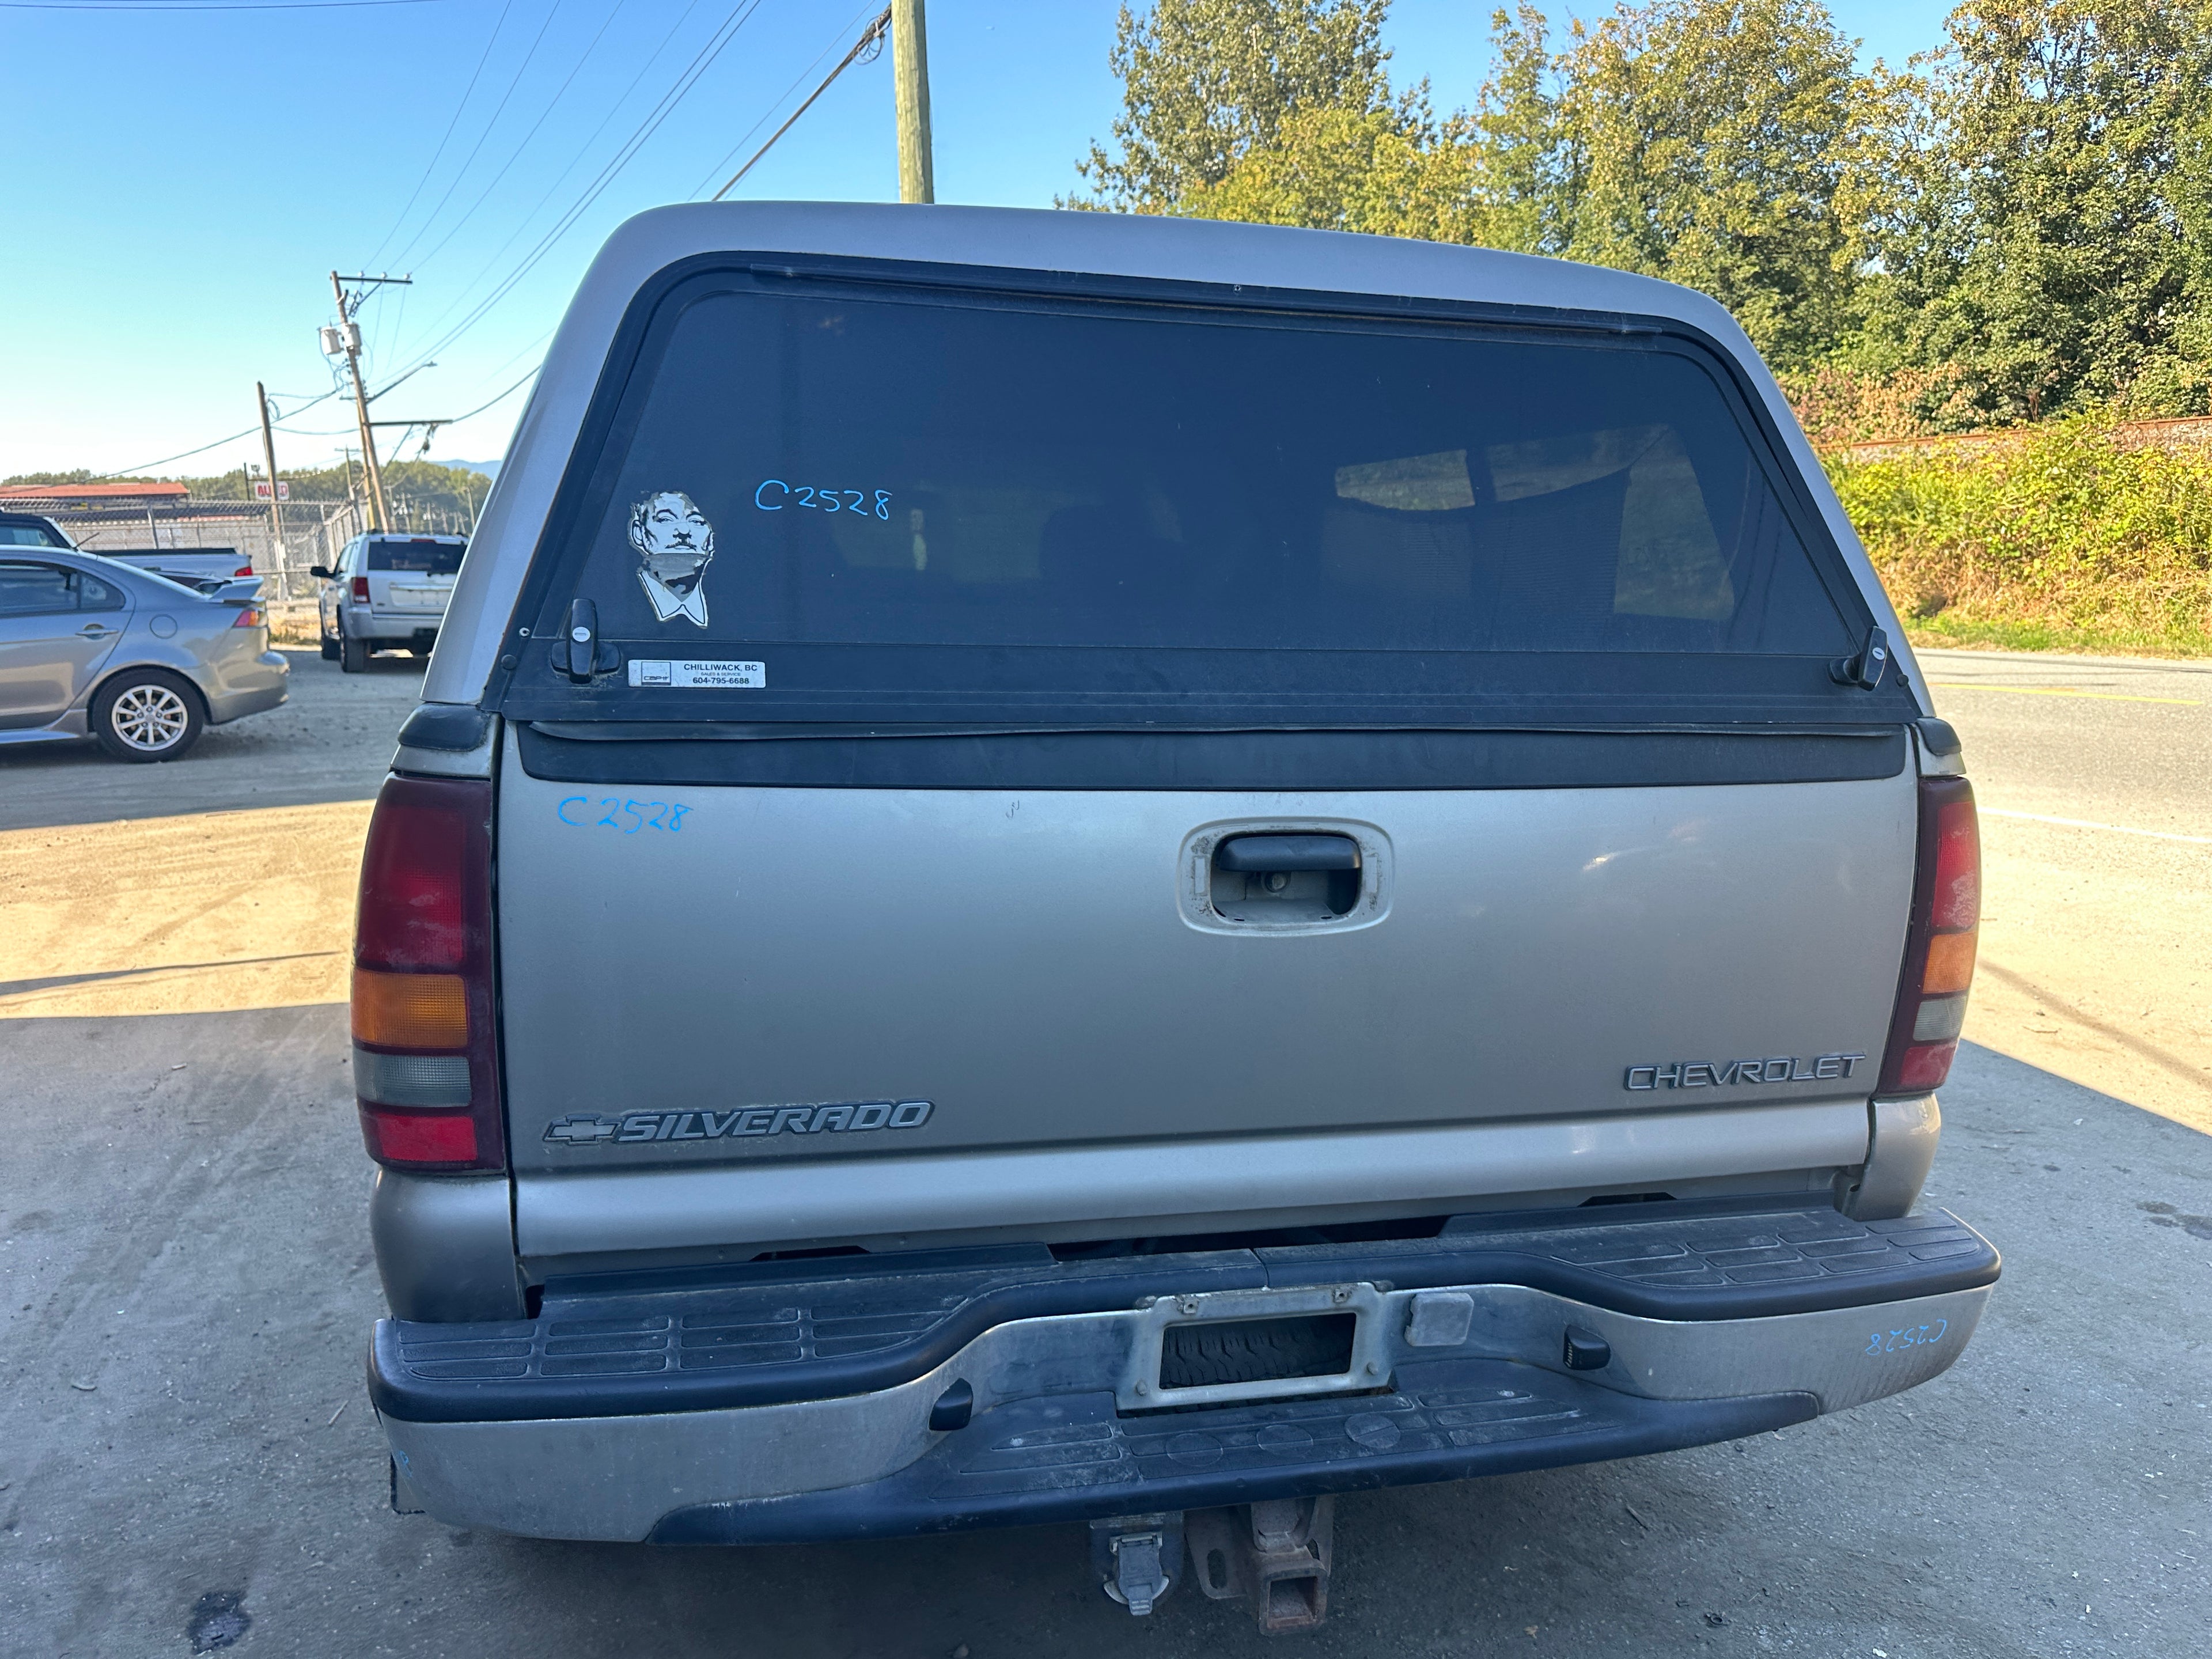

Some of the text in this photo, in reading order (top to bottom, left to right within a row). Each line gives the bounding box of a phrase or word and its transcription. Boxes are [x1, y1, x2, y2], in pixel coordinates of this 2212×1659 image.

[755, 479, 892, 520] C2528
[684, 664, 743, 672] CHILLIWACK,
[558, 796, 693, 834] C2528
[1623, 1054, 1866, 1090] CHEVROLET
[618, 1101, 934, 1143] SILVERADO
